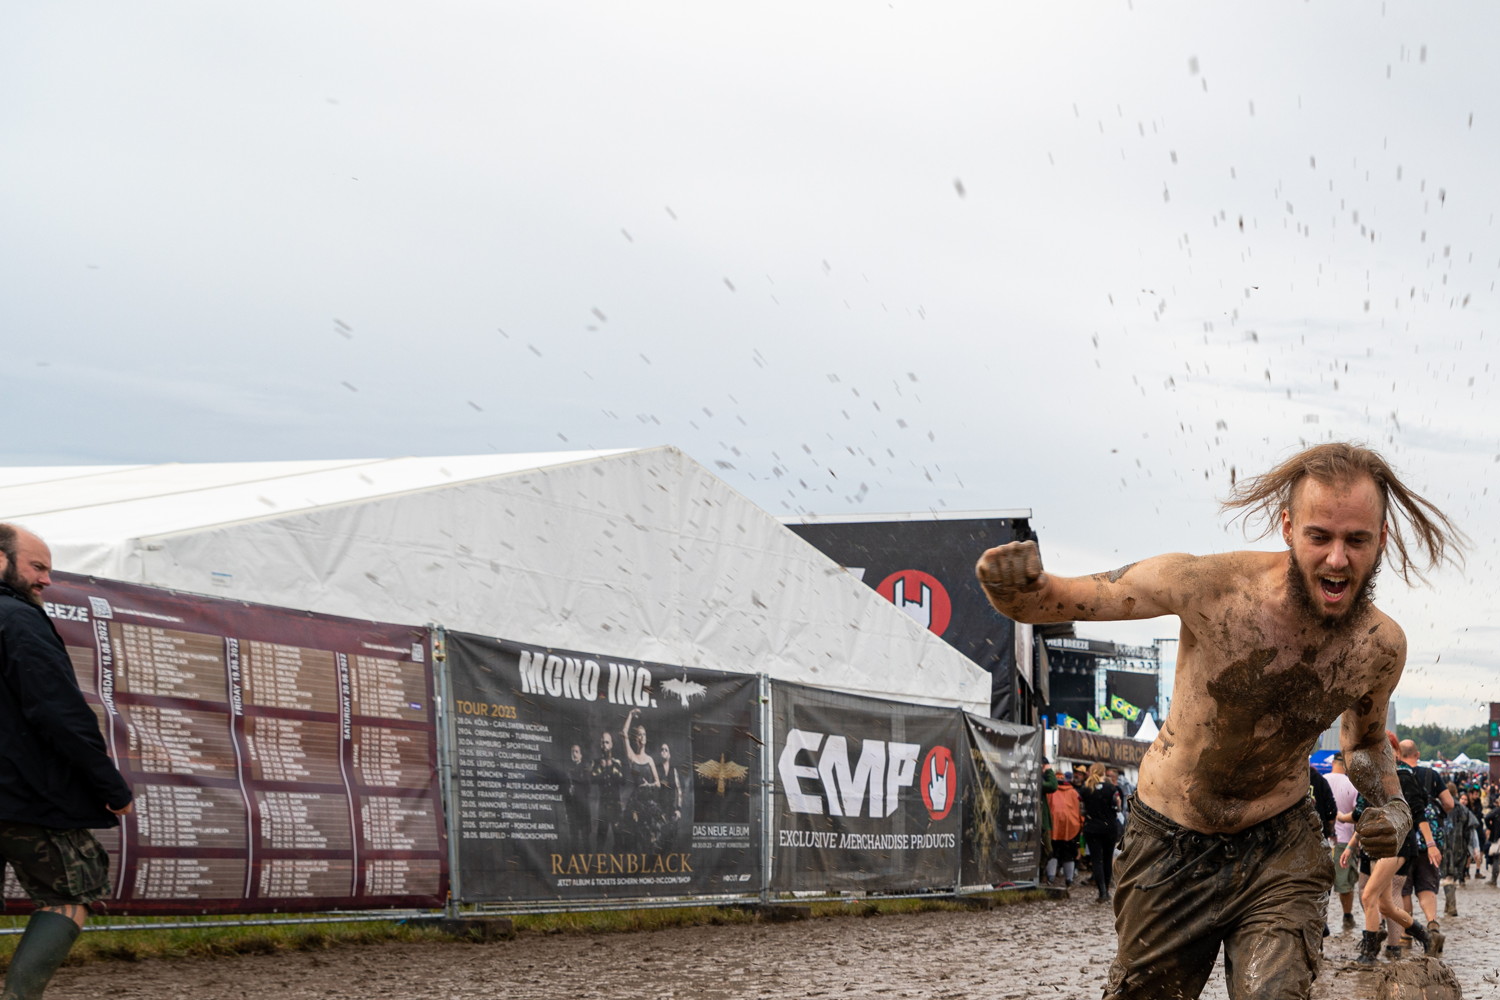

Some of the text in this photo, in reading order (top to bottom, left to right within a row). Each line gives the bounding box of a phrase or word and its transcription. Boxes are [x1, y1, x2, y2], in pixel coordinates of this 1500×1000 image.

[518, 650, 658, 709] MONO INC.
[102, 668, 119, 715] THURSDAY
[232, 684, 244, 716] FRIDAY
[341, 696, 351, 740] SATURDAY
[456, 699, 518, 720] TOUR 2023
[474, 717, 488, 726] KÖLN
[475, 730, 510, 738] OBERHAUSEN
[475, 740, 501, 748] HAMBURG
[506, 743, 540, 751] SPORTHALLE
[1081, 737, 1111, 759] BAND
[477, 770, 503, 778] MÜNCHEN
[778, 728, 921, 818] EMP
[477, 780, 501, 788] DRESDEN
[522, 783, 559, 791] SCHLACHTHOF
[479, 810, 496, 818] FÜRTH
[692, 825, 750, 837] DAS NEUE ALBUM
[779, 829, 956, 850] EXCLUSIVE MERCHANDISE PRODUCTS
[550, 853, 694, 875] RAVENBLACK
